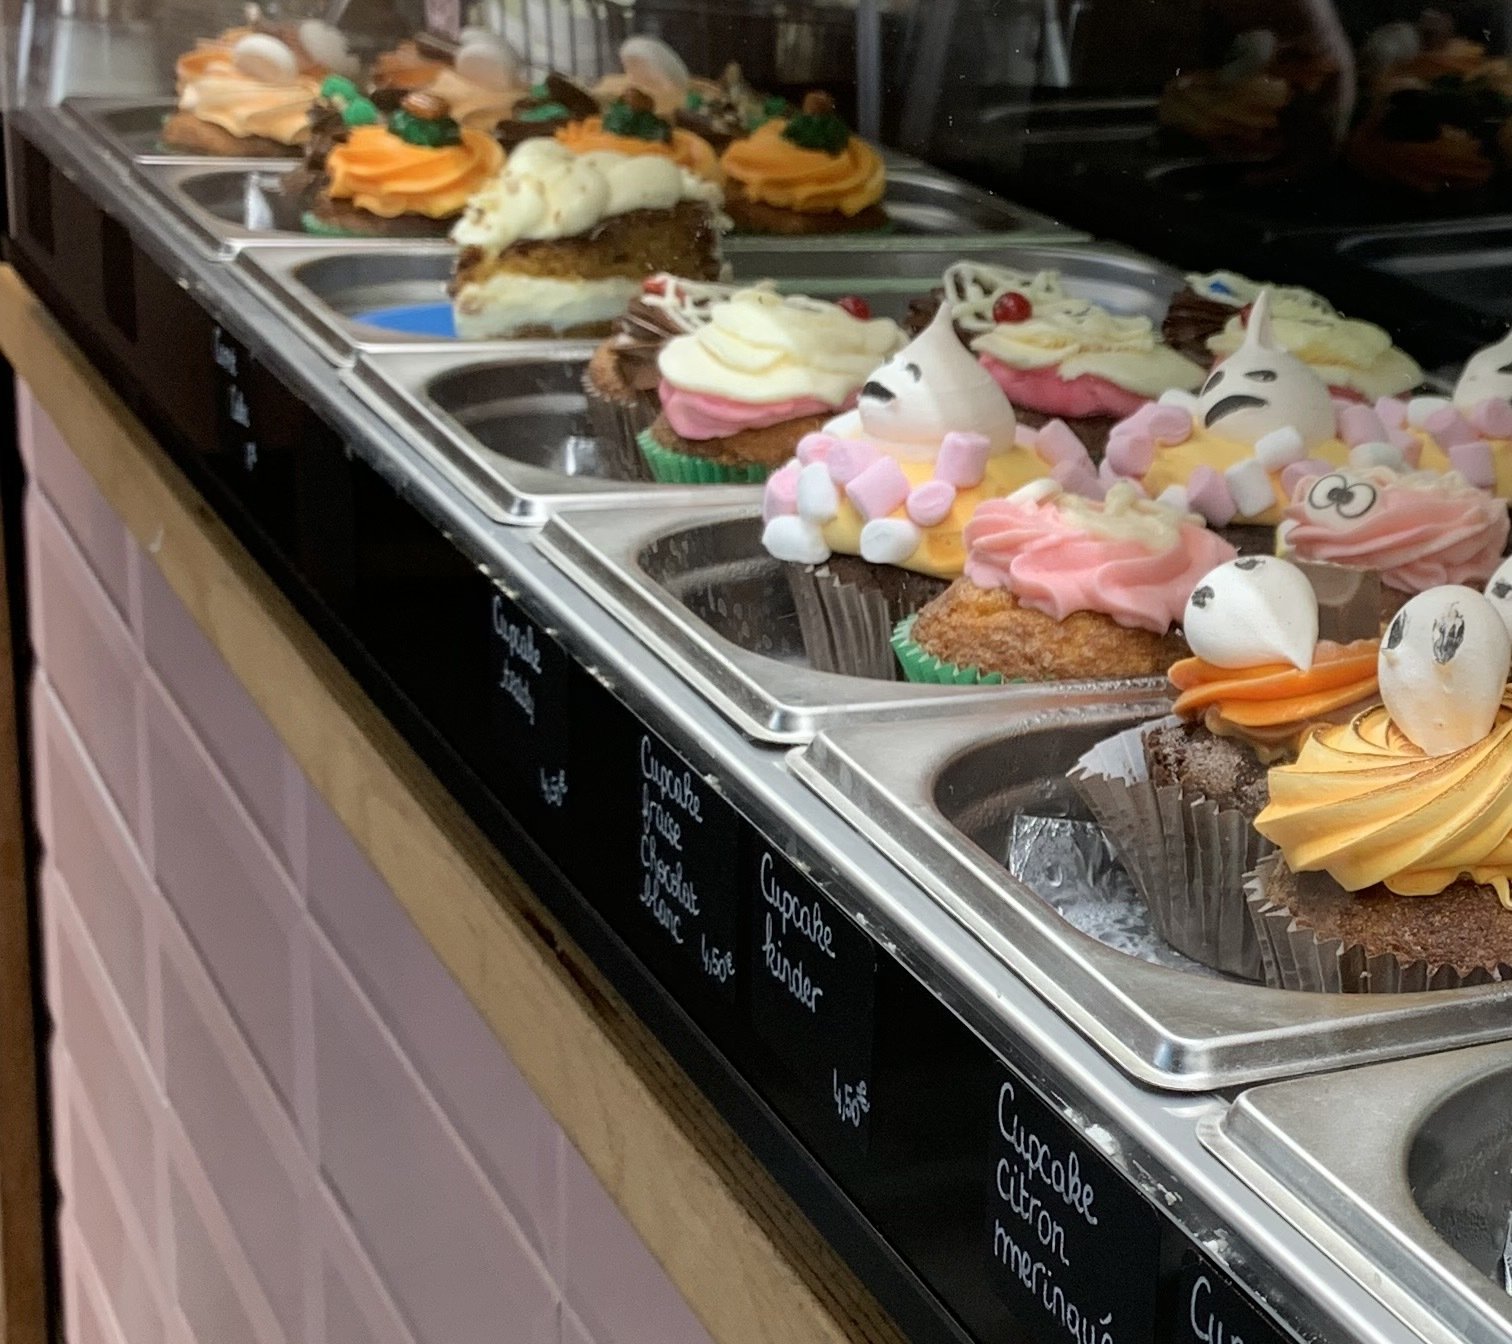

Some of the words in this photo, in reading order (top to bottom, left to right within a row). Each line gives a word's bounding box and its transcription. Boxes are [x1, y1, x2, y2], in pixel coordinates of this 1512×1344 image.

[641, 735, 703, 823] Cupcake
[642, 782, 683, 851] fraise
[640, 873, 684, 944] blanc
[760, 851, 836, 959] Cupcake
[761, 911, 823, 1013] kinder
[998, 1081, 1098, 1226] Cupcake
